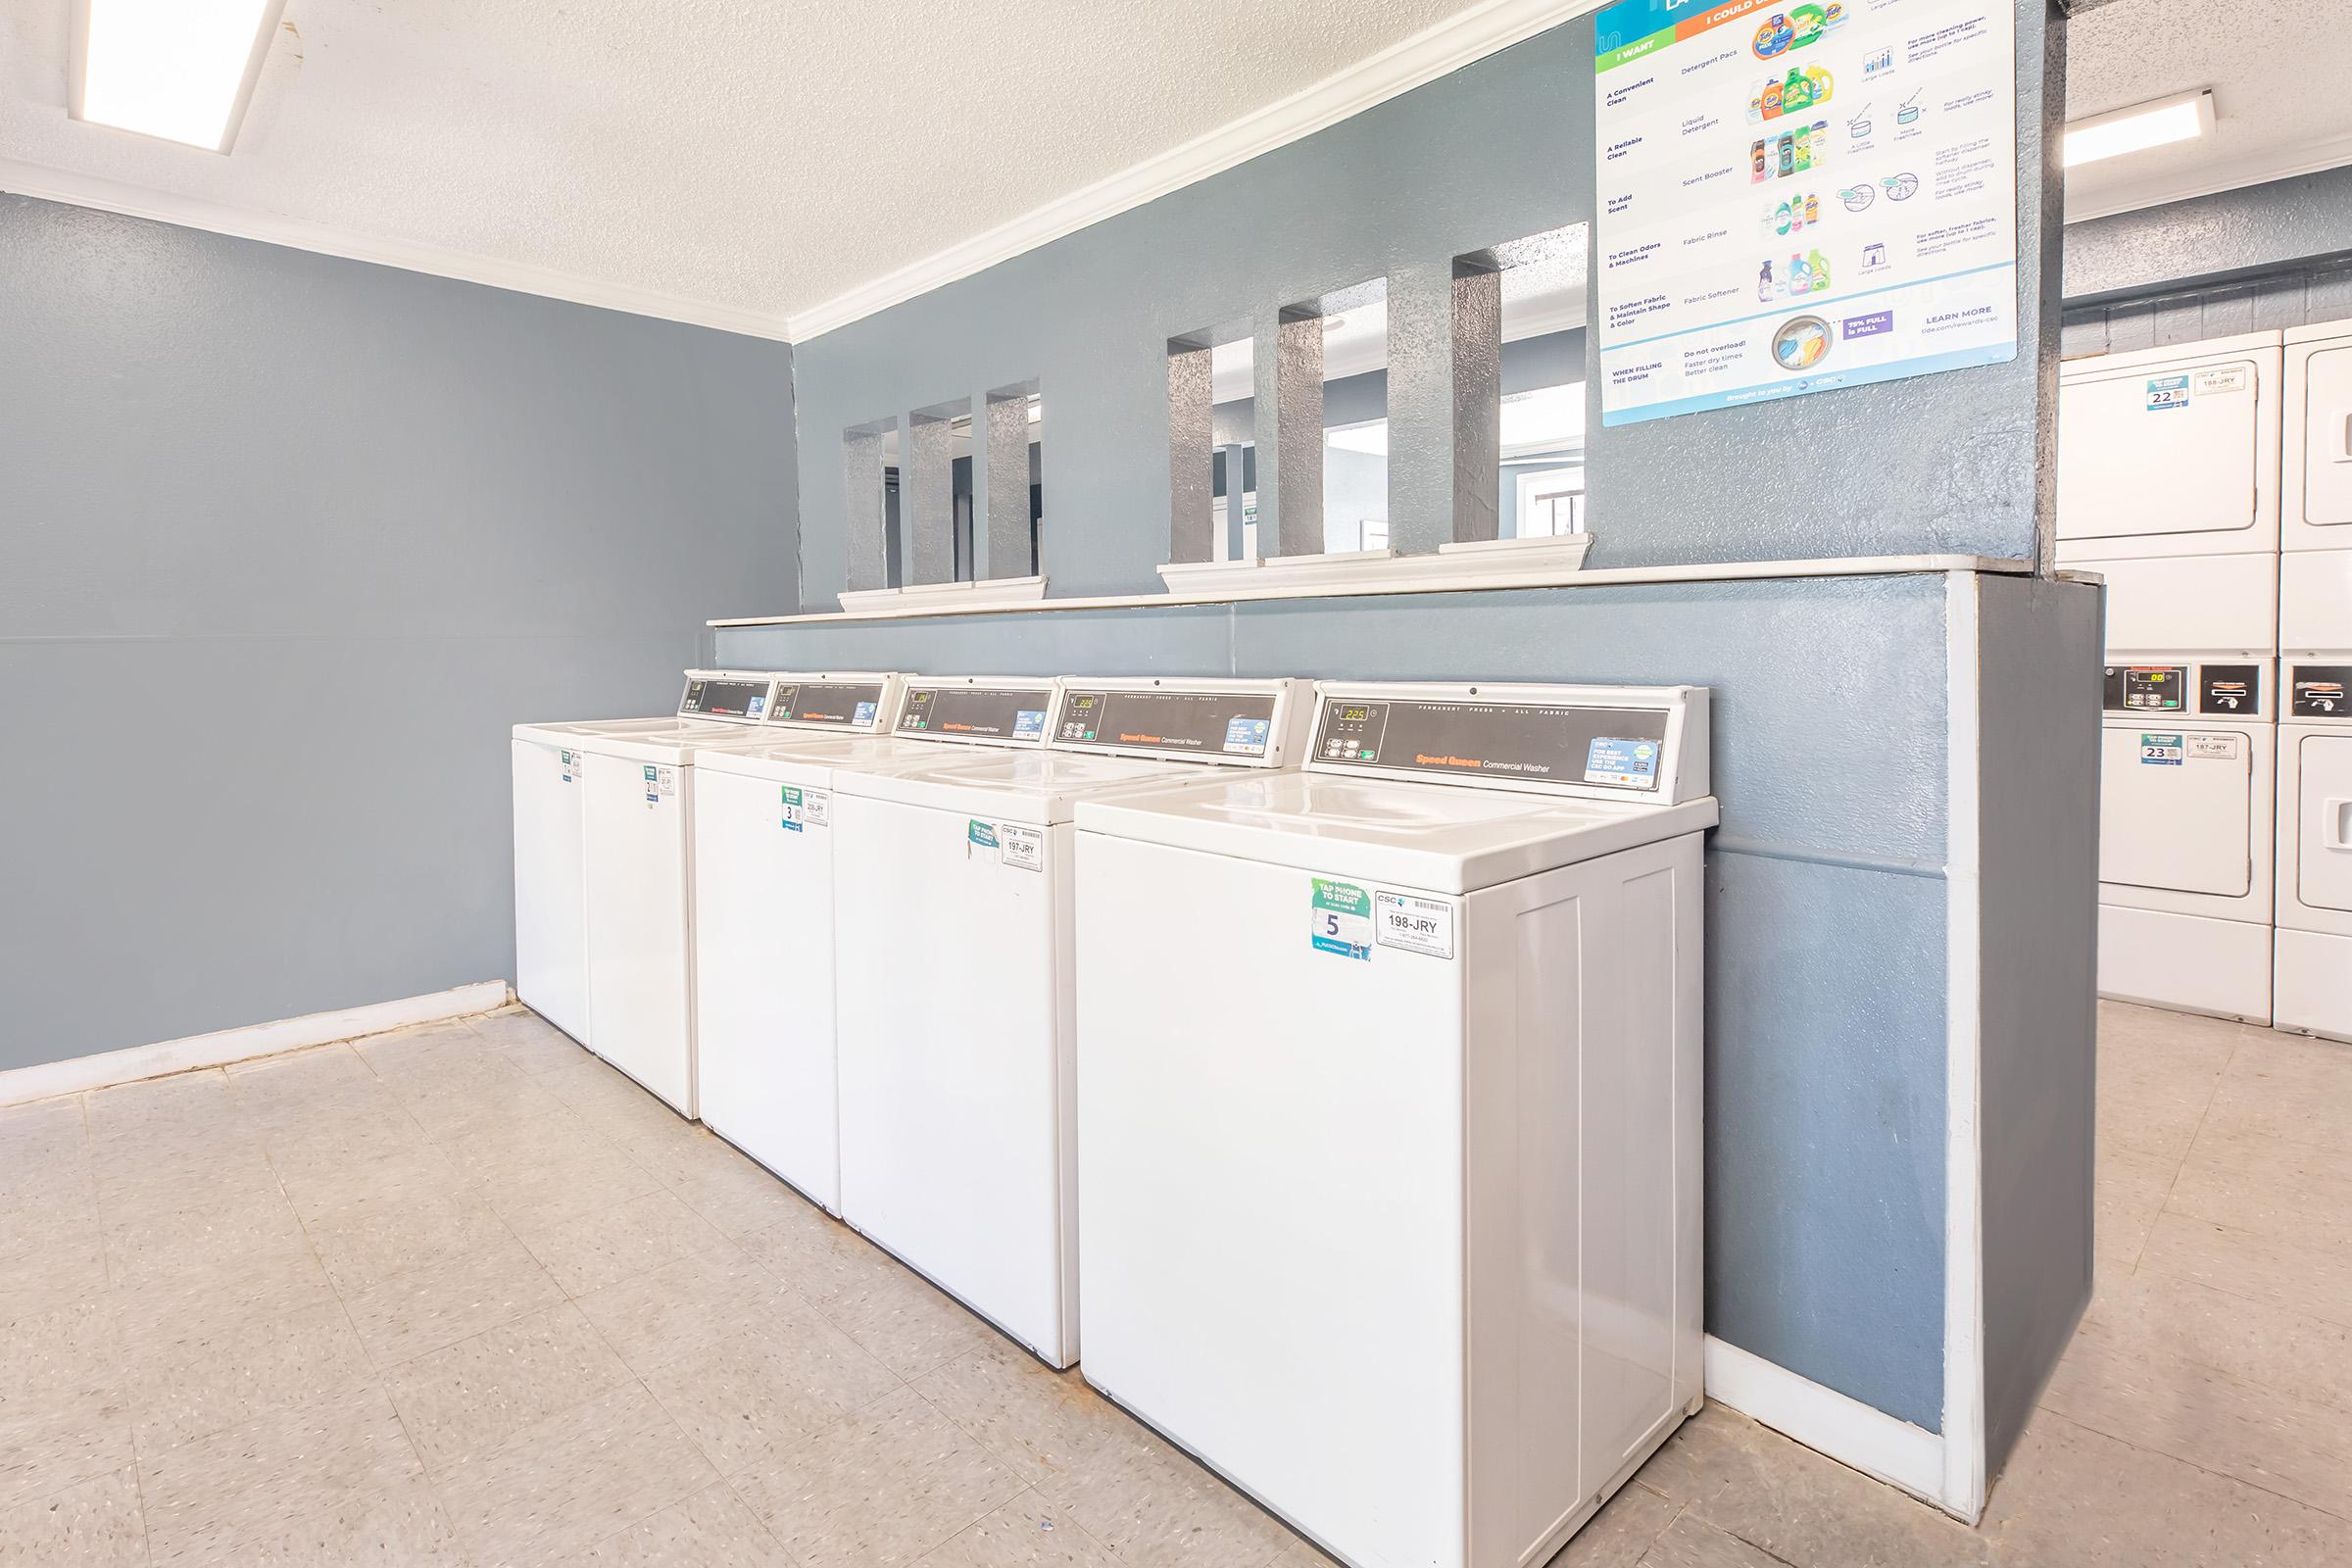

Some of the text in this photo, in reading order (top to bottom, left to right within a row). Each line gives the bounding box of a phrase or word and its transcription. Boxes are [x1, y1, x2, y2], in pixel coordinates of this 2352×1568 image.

[1706, 0, 1752, 24] I COULD
[1936, 23, 1963, 35] cleaning
[1616, 39, 1655, 62] I WANT
[1681, 50, 1739, 75] Detergent Pacs
[1614, 76, 1654, 97] Convenient
[1607, 96, 1627, 107] Clean
[1682, 115, 1704, 127] Liquid
[1682, 119, 1719, 135] Detergent
[1615, 137, 1642, 151] Reliable
[1607, 150, 1628, 161] Clean
[1682, 166, 1734, 187] Scent Booster
[1617, 194, 1633, 204] Add
[1607, 204, 1628, 215] Scent
[1683, 229, 1728, 246] Fabric Rinse
[1618, 247, 1638, 259] Clean
[1640, 241, 1661, 253] Odors
[1615, 253, 1649, 268] Machines
[1619, 298, 1642, 311] Soften
[1643, 294, 1667, 306] Fabric
[1684, 286, 1740, 305] Fabric Softener
[1616, 307, 1647, 319] Maintain
[1648, 302, 1671, 315] Shape
[1926, 306, 1992, 324] LEARN MORE
[1616, 318, 1636, 327] Color
[1866, 316, 1887, 324] FULL
[1857, 324, 1878, 333] FULL
[1684, 340, 1746, 359] Do not overload!
[1685, 352, 1743, 369] Faster dry times
[1612, 362, 1662, 377] WHEN FILLING
[1685, 364, 1729, 377] Better clean
[1627, 373, 1649, 383] DRUM
[1726, 391, 1757, 402] Brought
[1765, 386, 1782, 396] you
[2153, 392, 2171, 403] 22
[2147, 748, 2165, 757] 23
[1416, 754, 1550, 773] Speed Queen Commercial Washer
[787, 807, 792, 819] 3
[1008, 842, 1034, 855] 197-JRY
[1319, 884, 1362, 899] TAP PHONE
[1322, 891, 1359, 905] TO START
[1378, 895, 1396, 904] CSC
[1327, 913, 1339, 936] 5
[1389, 914, 1437, 933] 198-JRY
